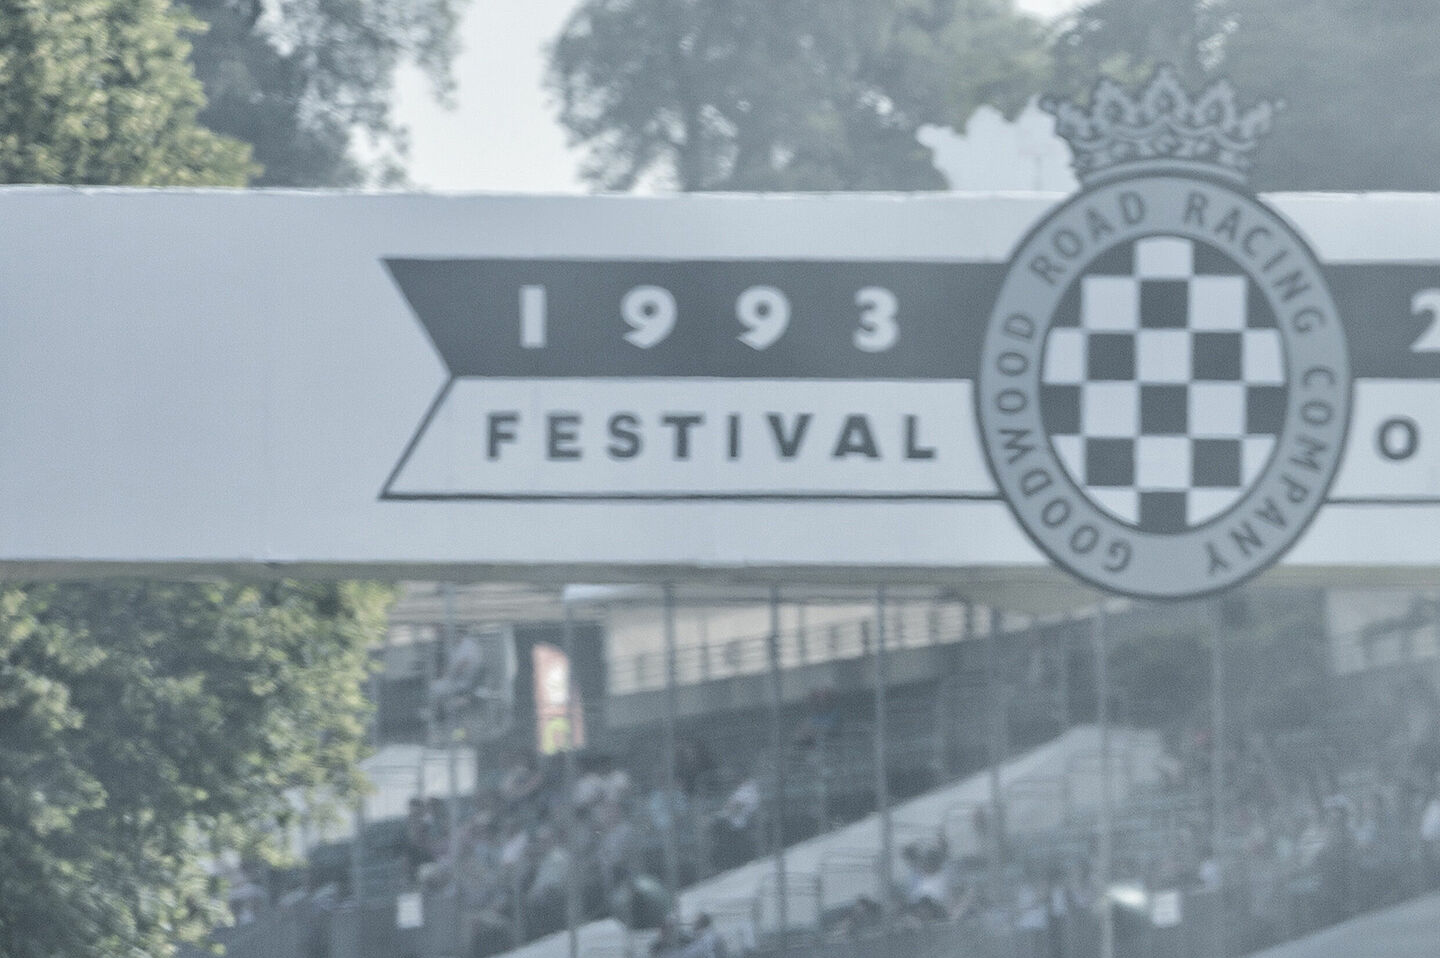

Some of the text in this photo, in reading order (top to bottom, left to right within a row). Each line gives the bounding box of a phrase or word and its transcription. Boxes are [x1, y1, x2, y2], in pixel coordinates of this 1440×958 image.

[518, 284, 900, 353] 1993
[998, 190, 1336, 577] GOODWOOD ROAD RACING COMPANY
[485, 411, 938, 461] FESTIVAL
